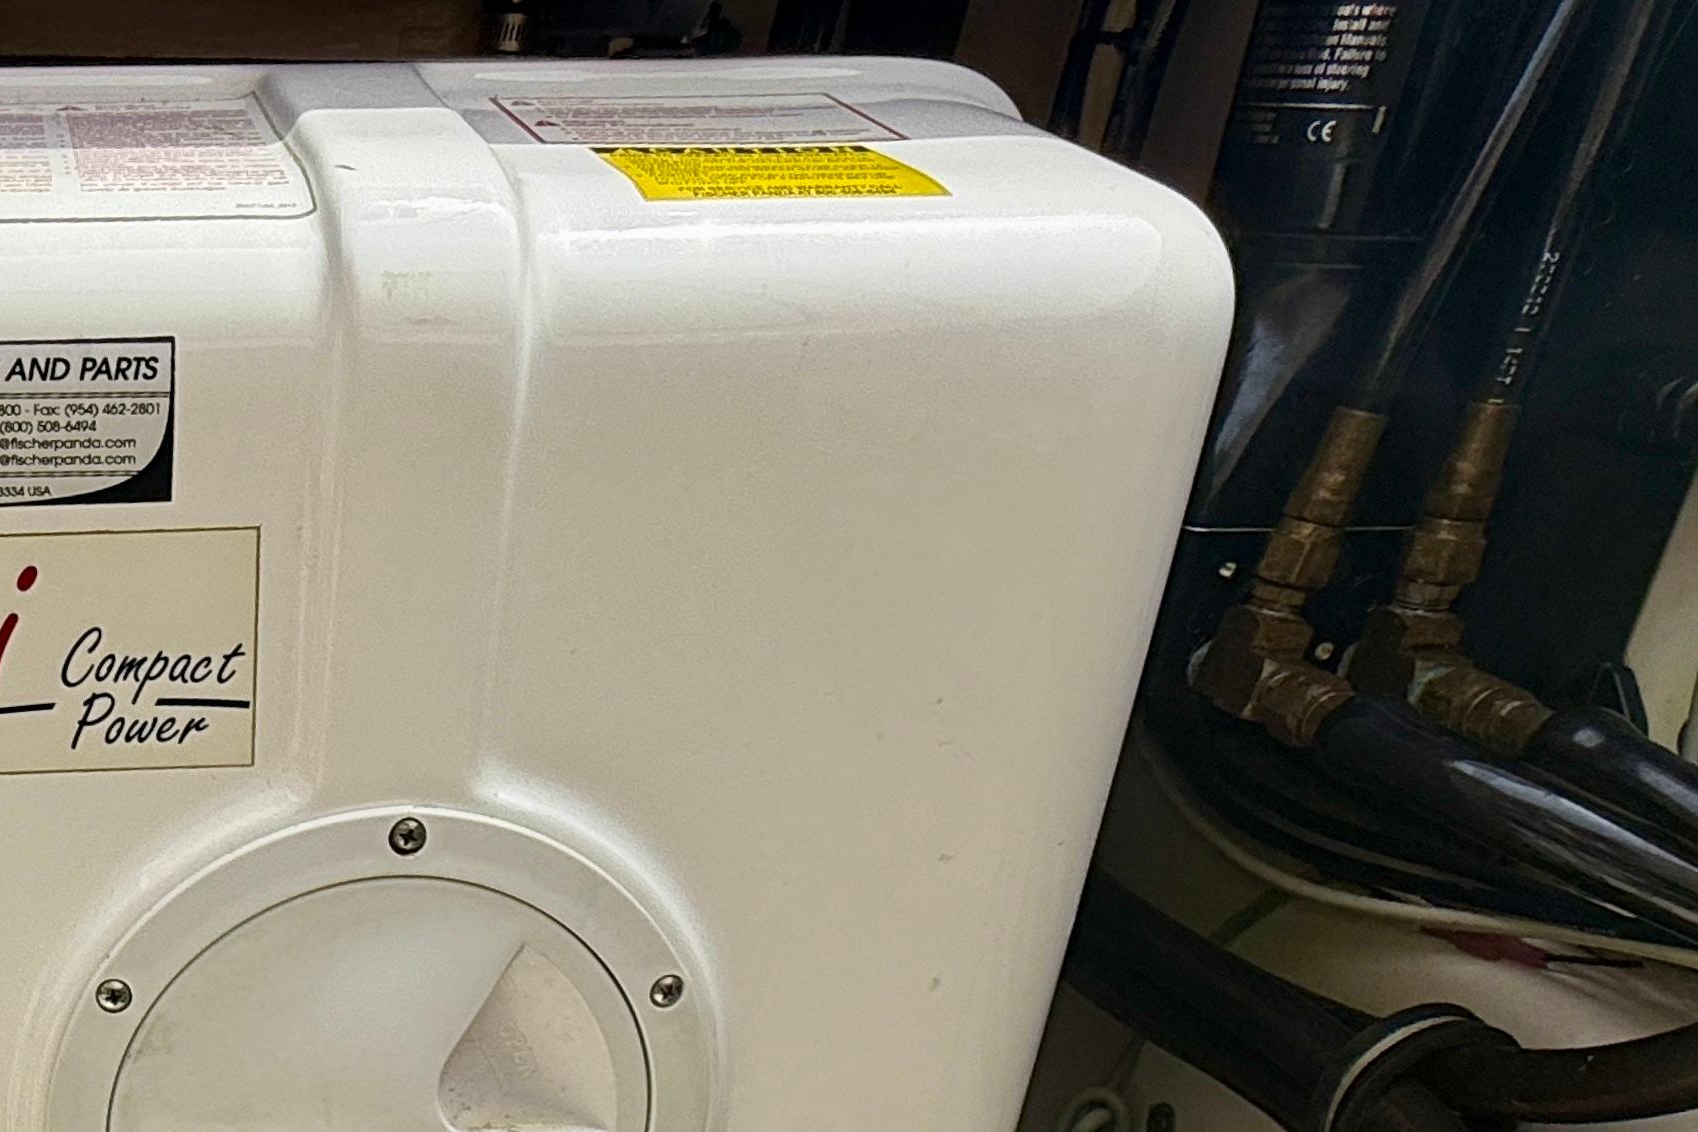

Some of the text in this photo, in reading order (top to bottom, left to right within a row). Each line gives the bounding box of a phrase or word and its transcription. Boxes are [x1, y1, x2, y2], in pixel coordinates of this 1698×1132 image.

[1306, 120, 1337, 142] CE
[5, 357, 71, 382] AND
[79, 356, 160, 382] PARTS
[33, 403, 60, 416] Fax:
[64, 402, 99, 418] (954)
[102, 402, 161, 416] 462-2801
[0, 420, 33, 435] (800)
[36, 420, 97, 432] 508-6494
[27, 486, 52, 497] USA
[61, 627, 247, 704] Compact
[70, 692, 210, 750] Power
